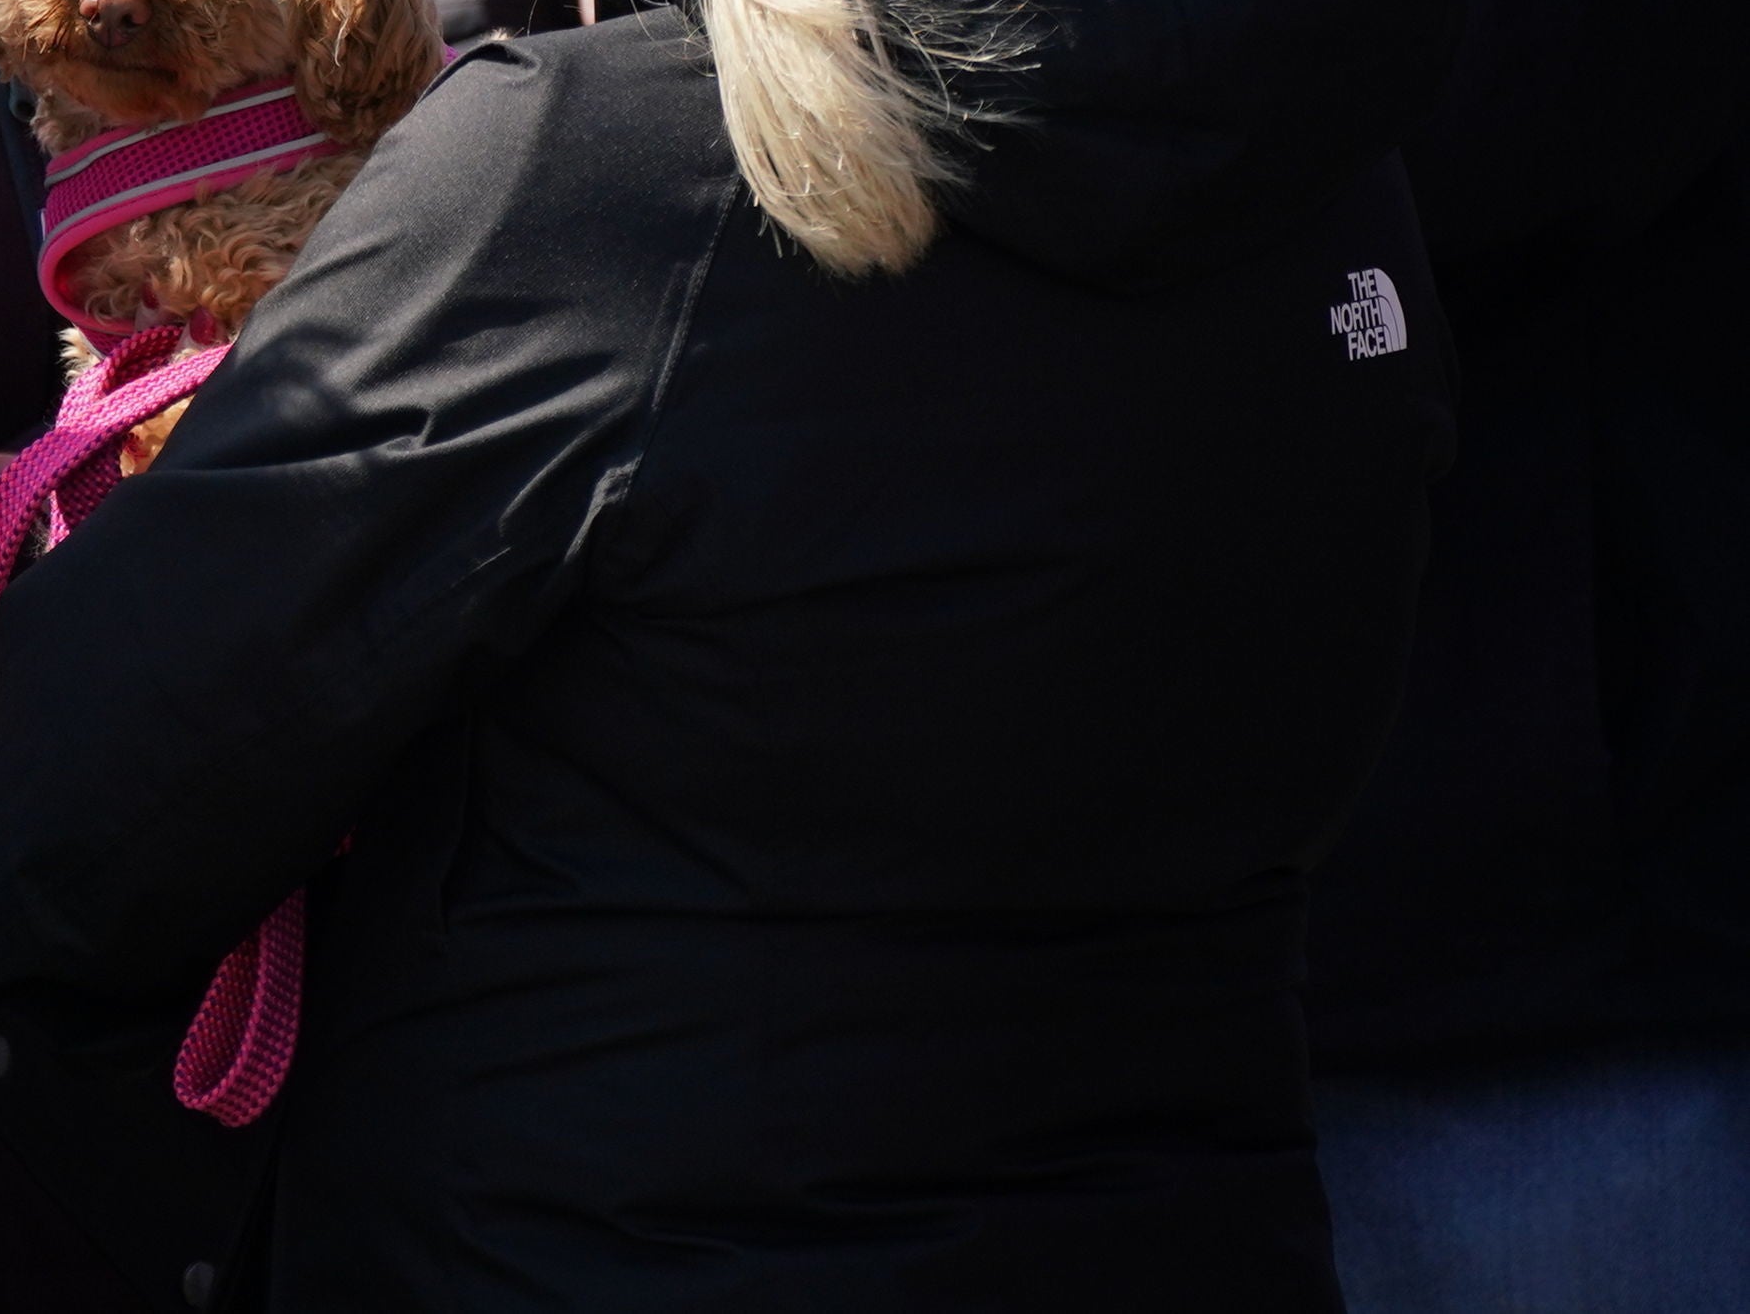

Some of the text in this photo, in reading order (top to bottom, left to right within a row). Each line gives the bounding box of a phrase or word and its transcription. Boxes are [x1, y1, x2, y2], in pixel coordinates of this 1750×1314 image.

[1348, 269, 1377, 301] THE
[1330, 297, 1382, 335] NORTH
[1347, 326, 1387, 361] FACE
